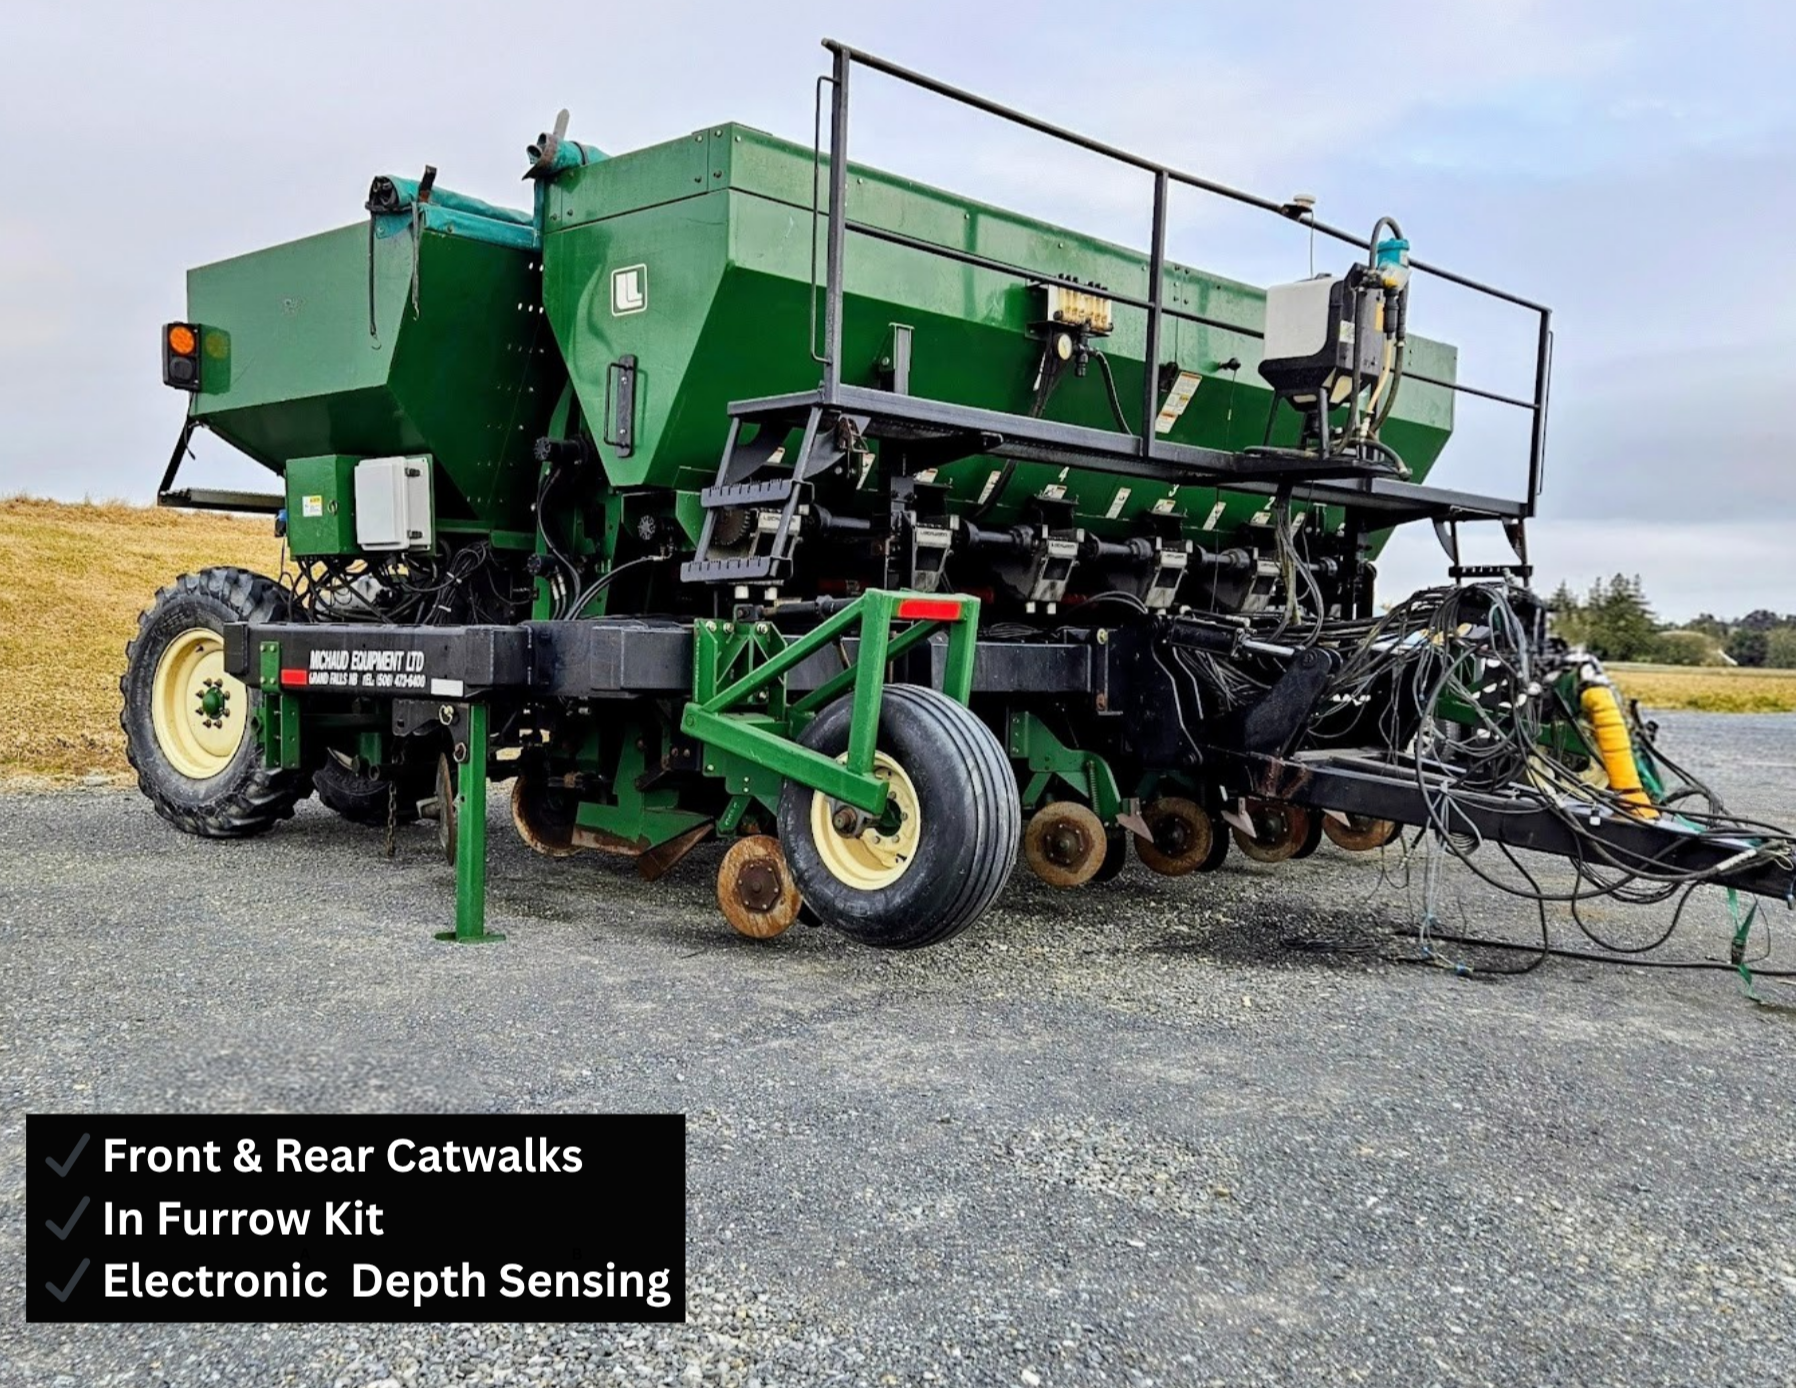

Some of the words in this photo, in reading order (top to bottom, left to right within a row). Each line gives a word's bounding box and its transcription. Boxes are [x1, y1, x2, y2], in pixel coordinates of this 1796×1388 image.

[309, 650, 350, 671] MICHAUD
[350, 650, 405, 672] EQUIPMENT
[405, 650, 425, 672] LTD
[329, 671, 349, 686] FALLS
